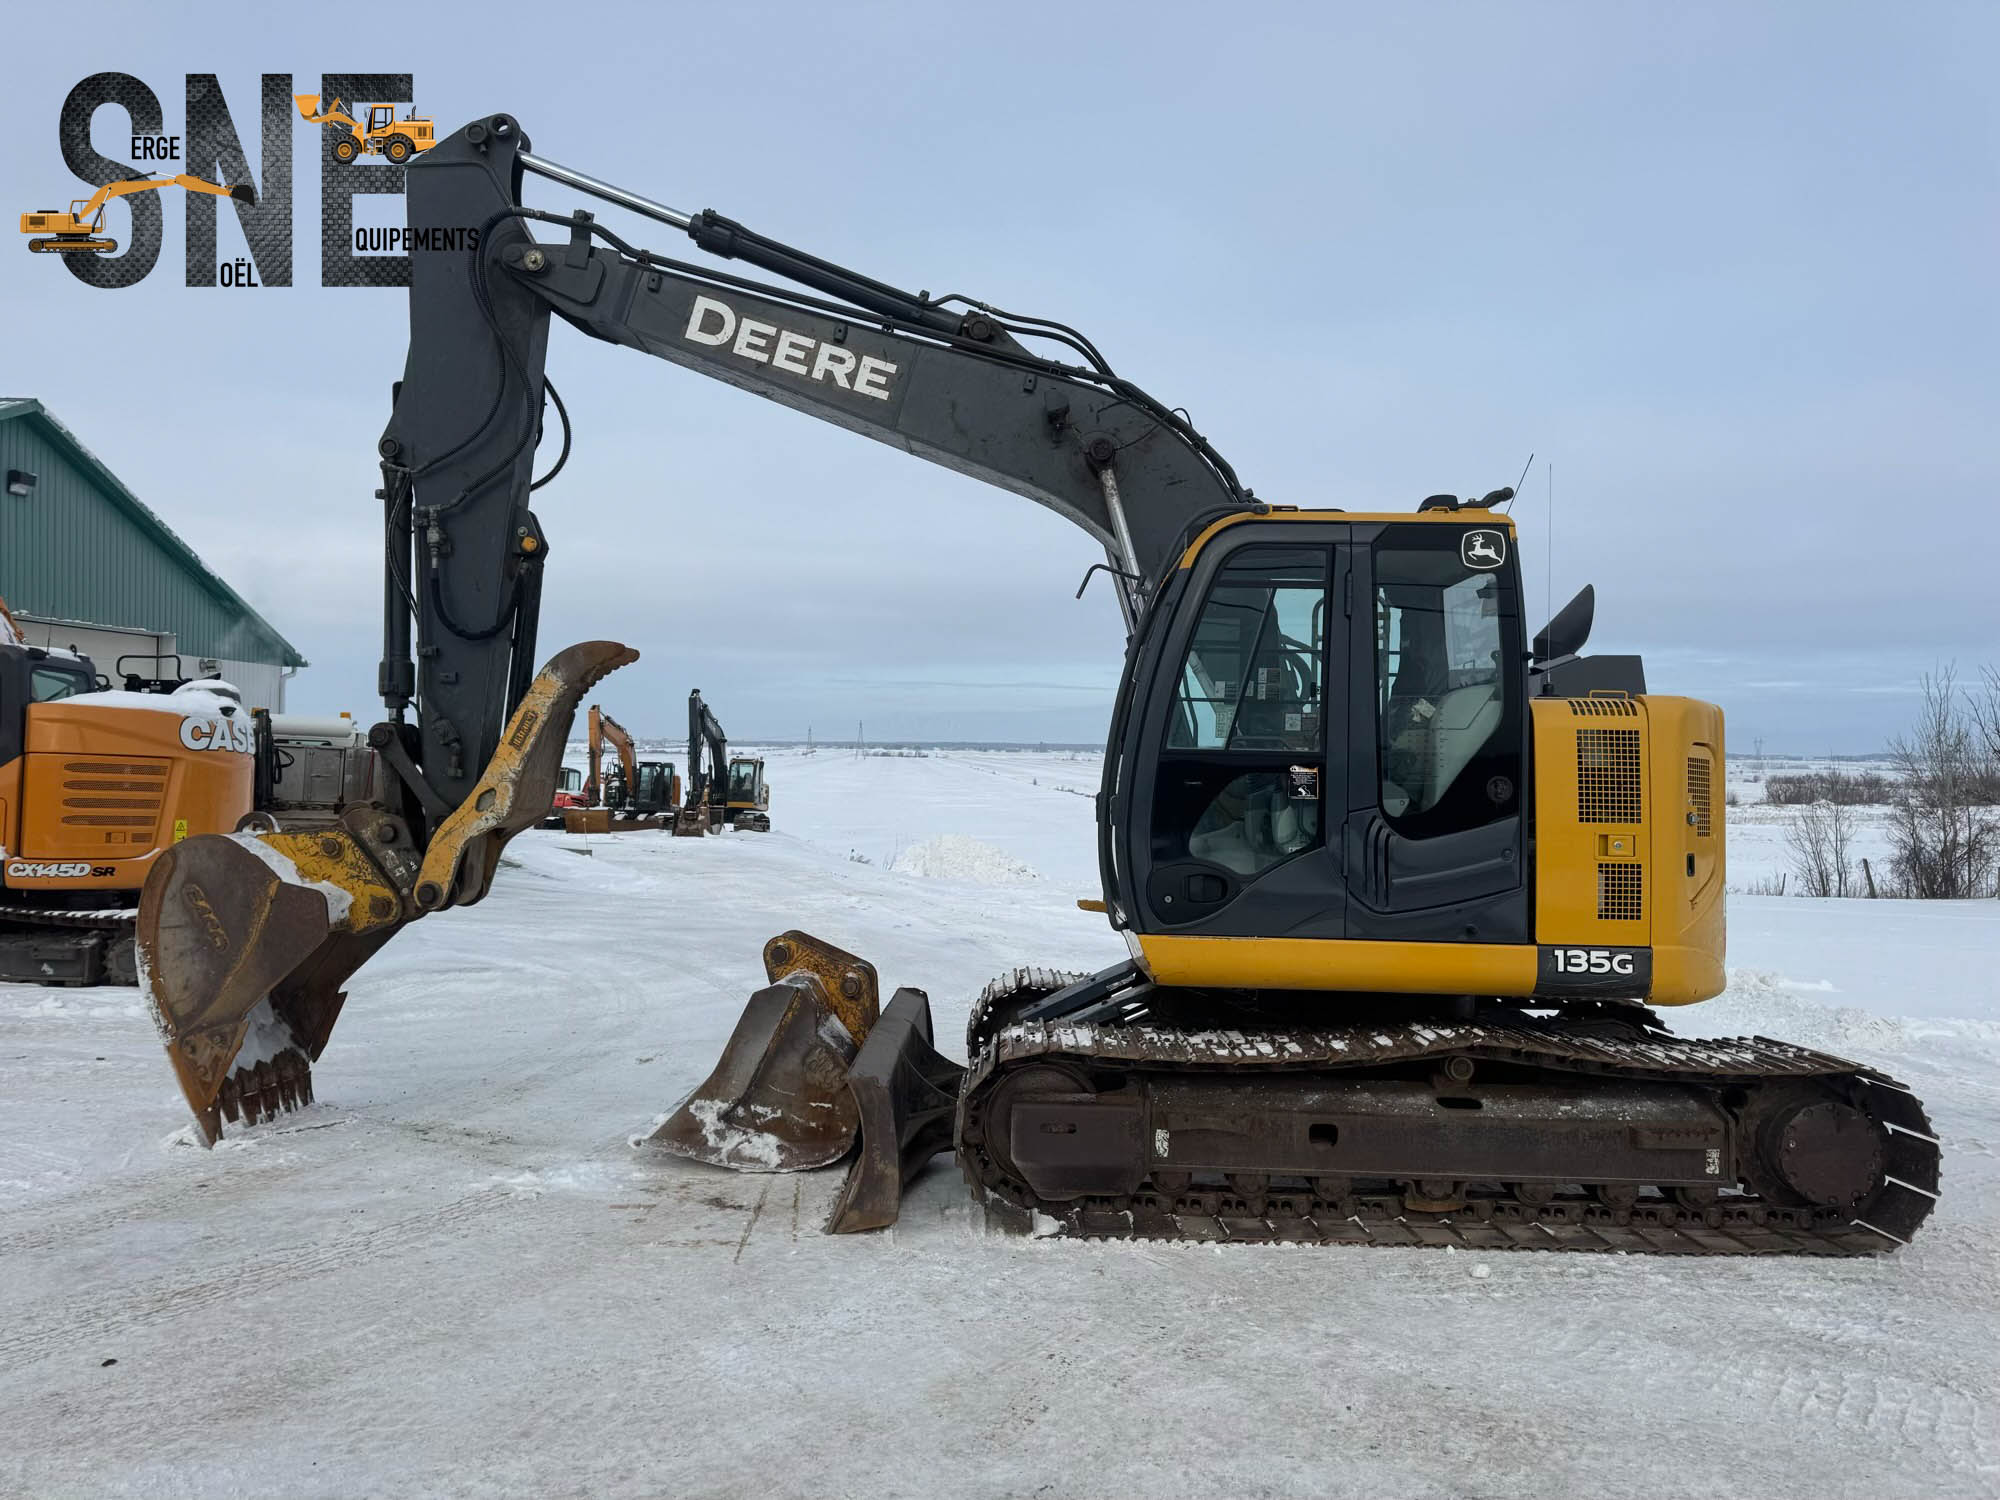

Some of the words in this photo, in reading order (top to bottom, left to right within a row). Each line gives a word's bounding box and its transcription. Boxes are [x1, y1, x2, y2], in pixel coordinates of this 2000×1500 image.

[684, 295, 898, 400] DEERE
[7, 862, 92, 877] CX145D
[91, 866, 116, 877] SR
[1553, 949, 1634, 974] 135G
